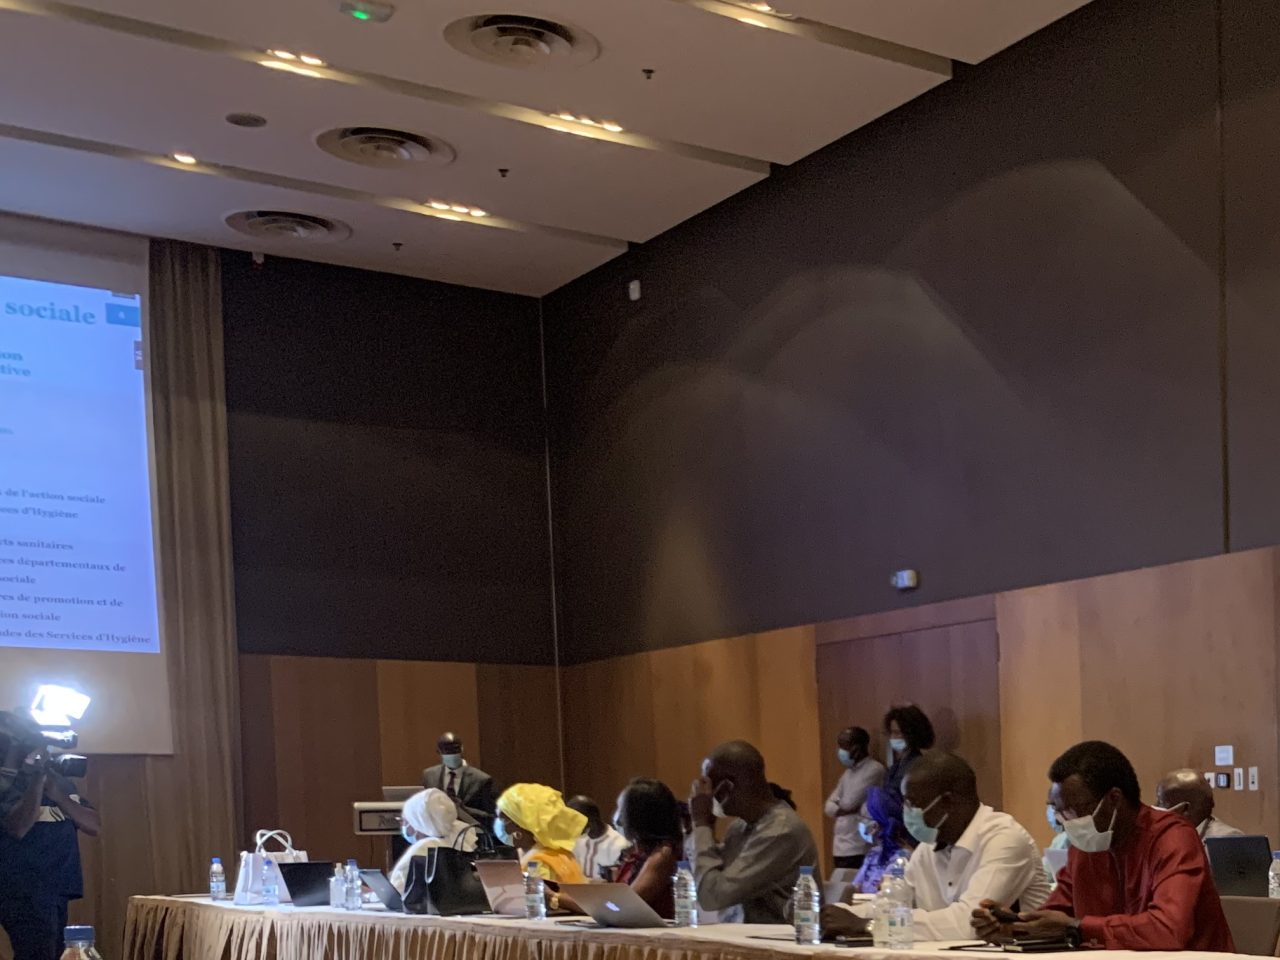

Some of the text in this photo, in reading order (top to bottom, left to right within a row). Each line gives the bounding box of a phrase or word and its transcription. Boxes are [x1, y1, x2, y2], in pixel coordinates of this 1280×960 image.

[5, 301, 96, 325] sociale
[0, 352, 23, 362] on
[5, 489, 106, 505] de l'action sociale
[21, 507, 79, 520] d'Hygiène
[16, 539, 74, 551] sanitaires
[17, 557, 111, 573] départementaux
[113, 563, 127, 573] de
[17, 593, 31, 602] de
[33, 595, 96, 607] promotion
[96, 598, 107, 607] et
[109, 598, 124, 608] de
[22, 611, 62, 622] sociale
[24, 629, 45, 639] des
[46, 630, 93, 641] Services
[95, 633, 152, 645] d'Hygiène
